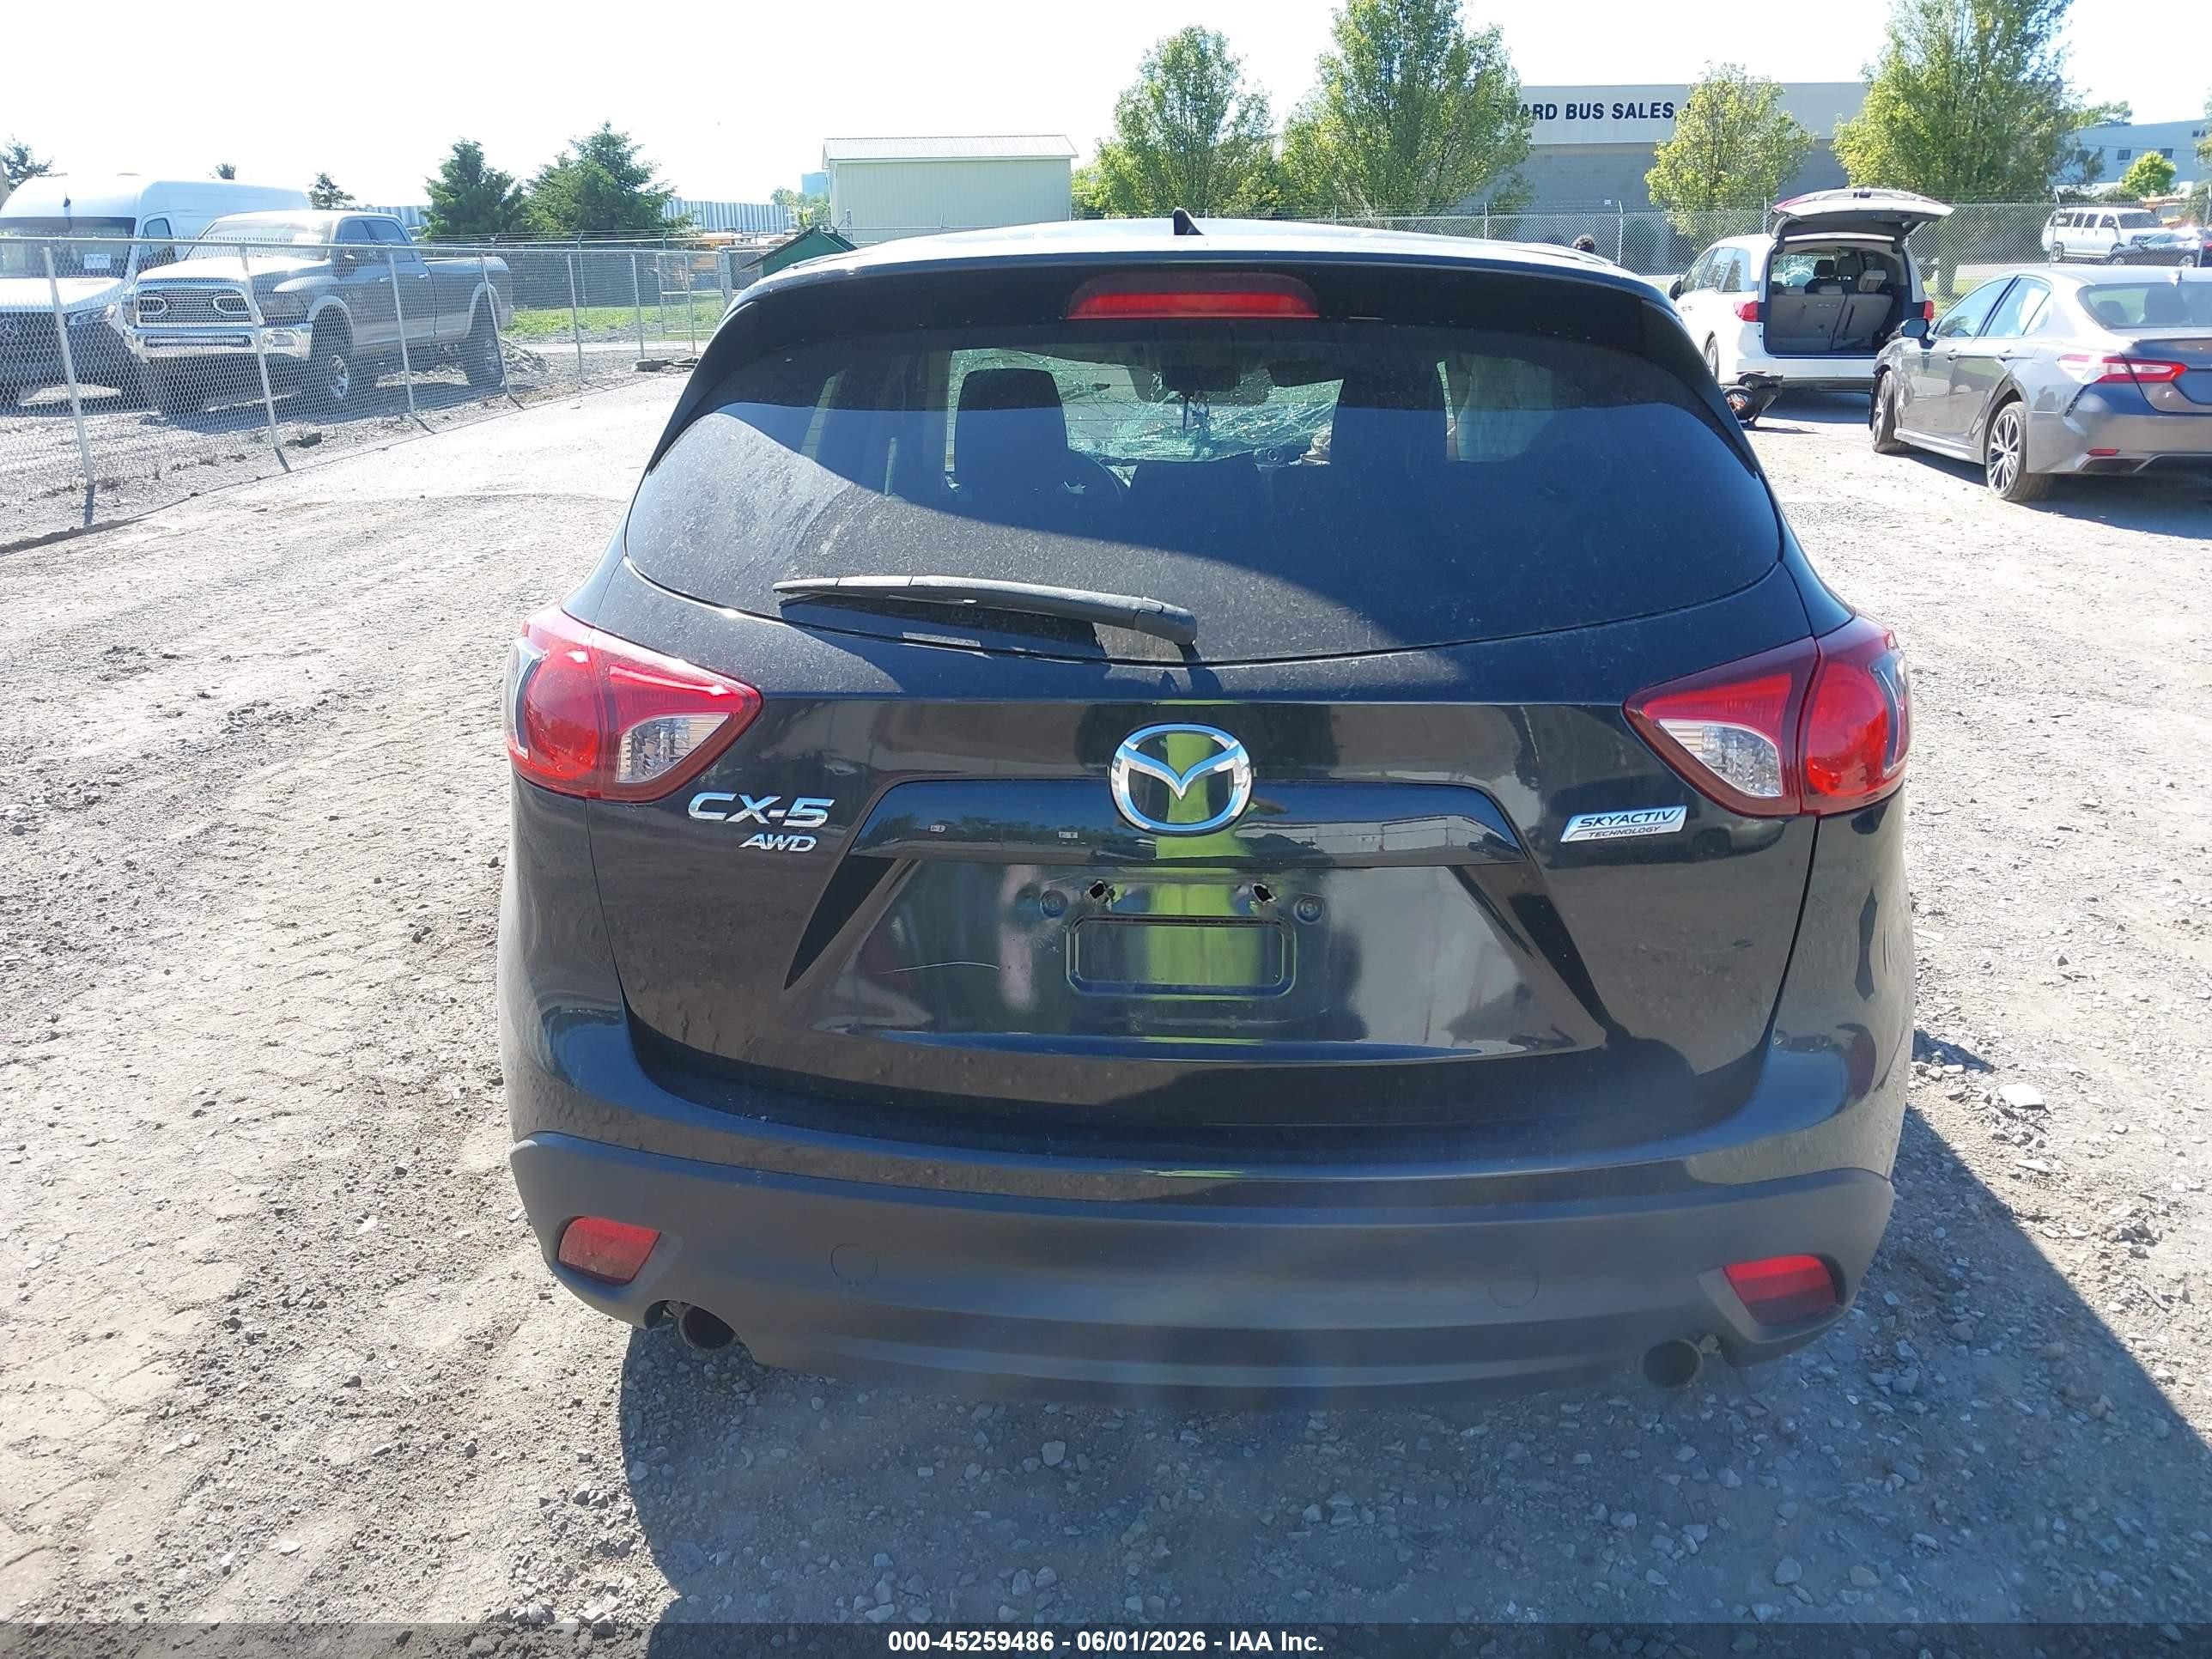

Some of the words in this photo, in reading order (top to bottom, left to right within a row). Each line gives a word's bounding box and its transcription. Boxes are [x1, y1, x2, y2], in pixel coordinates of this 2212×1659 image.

[1520, 103, 1558, 120] ARD
[1565, 102, 1605, 120] BUS
[688, 793, 835, 829] CX-5
[1578, 810, 1676, 829] SKYACTIV
[1589, 826, 1662, 838] TECHNOLOGY
[738, 833, 817, 853] AWD
